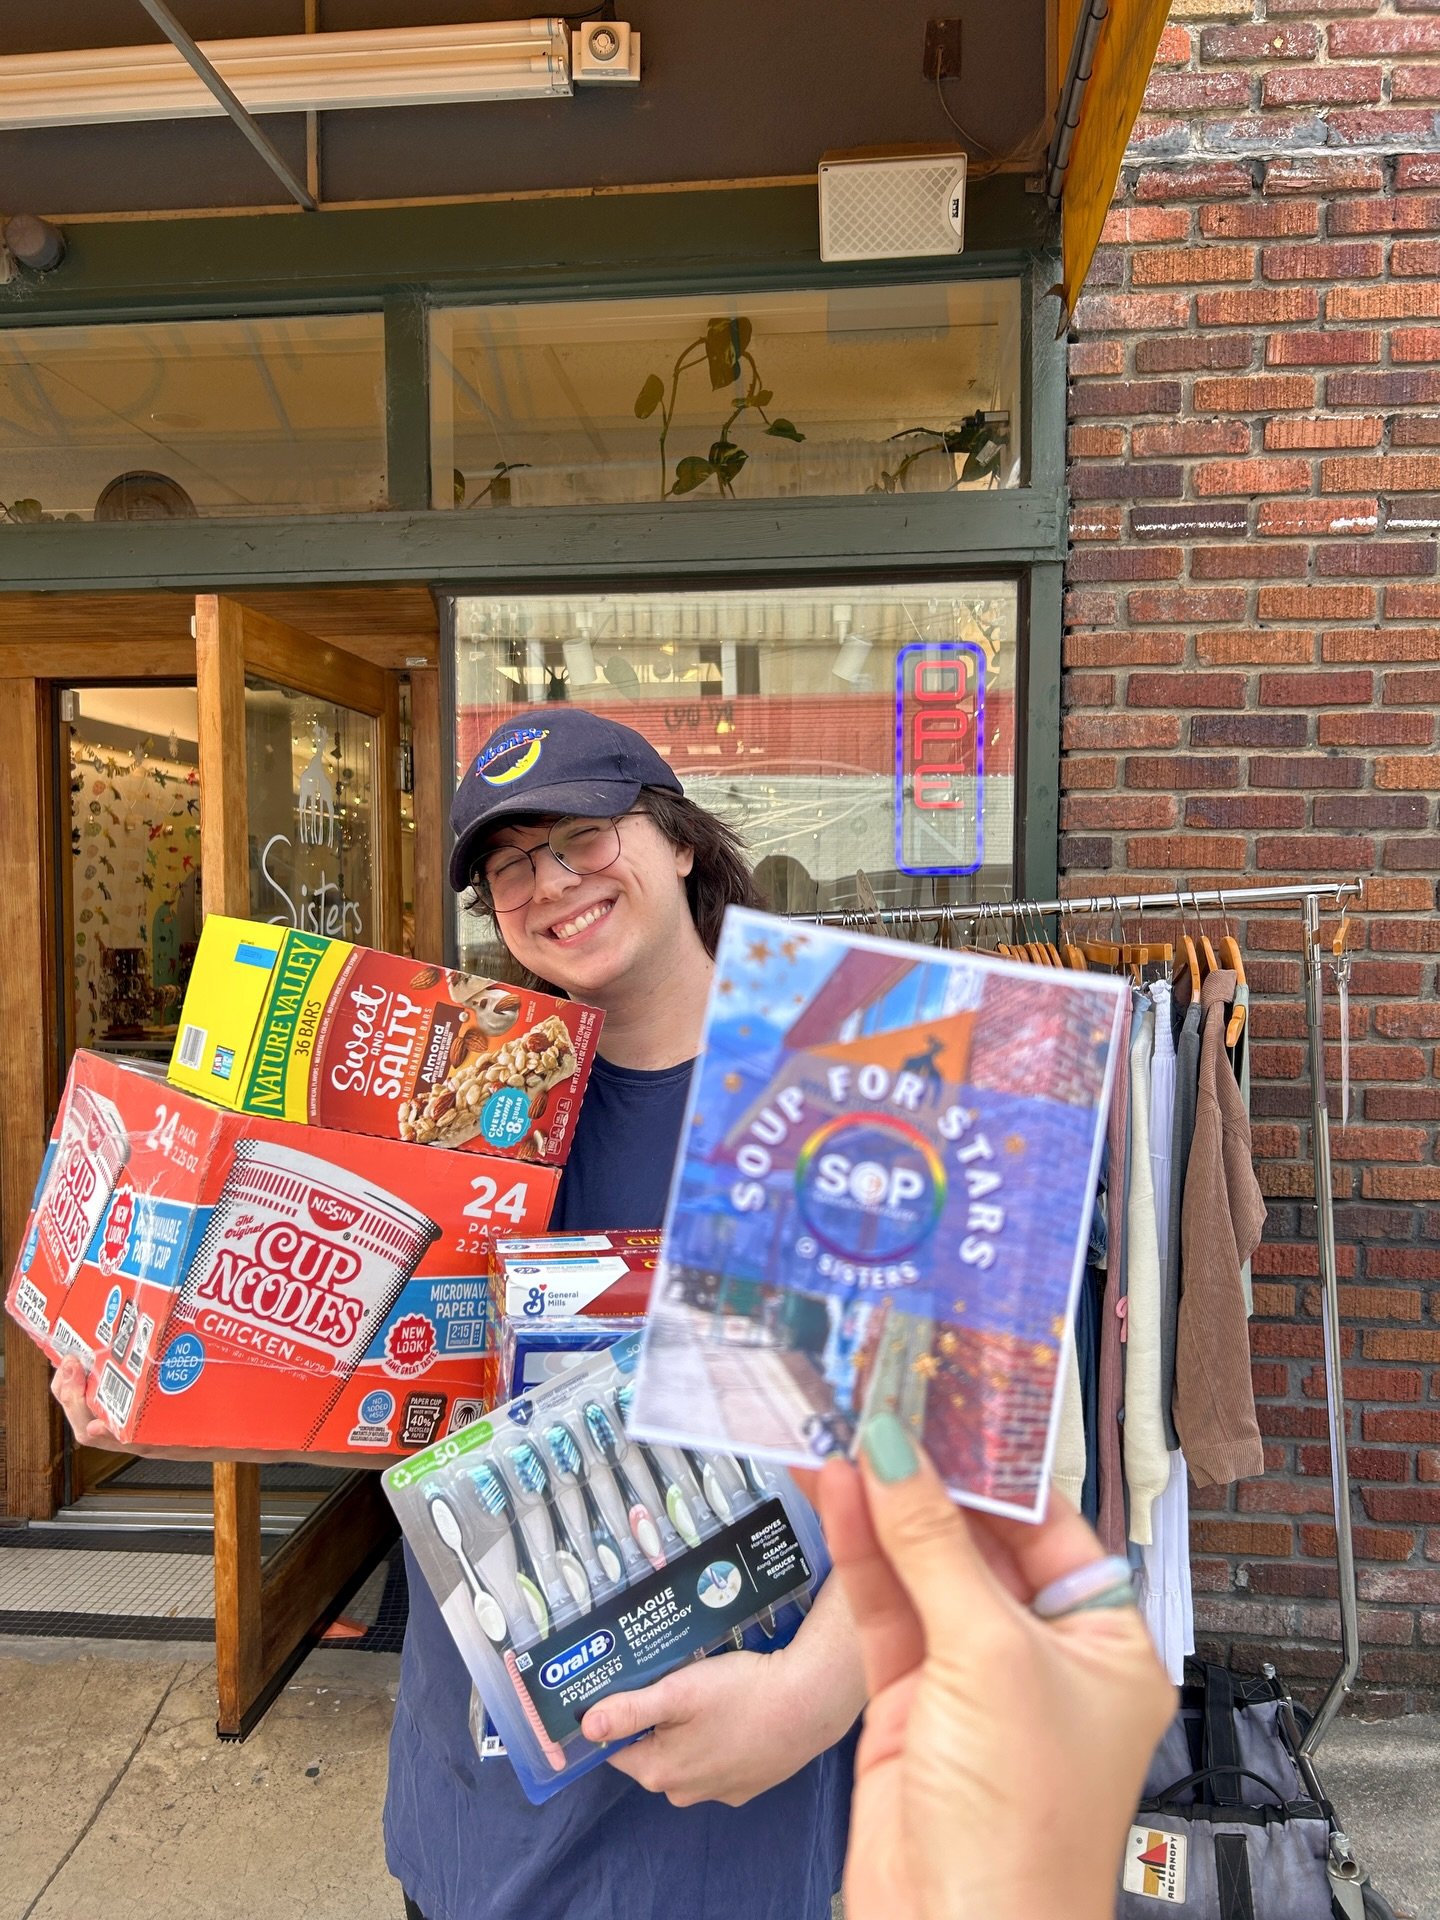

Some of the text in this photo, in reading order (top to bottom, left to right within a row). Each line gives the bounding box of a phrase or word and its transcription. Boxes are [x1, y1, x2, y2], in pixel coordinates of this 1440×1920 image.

[913, 659, 969, 863] OPEN
[262, 834, 362, 937] Sisters
[250, 938, 325, 1111] NATURE VALLEY
[294, 1000, 322, 1056] 36 BARS
[331, 984, 387, 1091] Sweet
[370, 1030, 385, 1056] AND
[373, 994, 422, 1099] SALTY
[401, 1007, 432, 1098] NUT GRANOLA BARS
[421, 1024, 445, 1083] Almond
[827, 1063, 927, 1111] FOR
[495, 1097, 514, 1137] Creamy
[511, 1096, 523, 1121] SUGAR
[146, 1104, 181, 1157] 24
[730, 1086, 804, 1212] SOUP
[66, 1142, 96, 1202] CUP
[186, 1154, 199, 1174] OZ
[462, 1176, 528, 1223] 24
[937, 1104, 1005, 1271] STARS
[49, 1177, 88, 1262] OODLES
[114, 1204, 130, 1223] NEW
[236, 1215, 254, 1227] The
[311, 1197, 355, 1224] NISSIN
[41, 1212, 62, 1261] CHICKEN
[107, 1225, 127, 1245] LOOK!
[224, 1223, 264, 1240] Original
[154, 1245, 171, 1270] CUP
[258, 1225, 359, 1291] CUP
[818, 1252, 920, 1291] SISTERS
[200, 1252, 361, 1345] NOODLES
[547, 1299, 566, 1307] Mills
[548, 1291, 579, 1300] General
[435, 1302, 475, 1319] PAPER
[203, 1314, 295, 1360] CHICKEN
[401, 1326, 426, 1340] NEW
[451, 1325, 469, 1339] 2:15
[175, 1343, 191, 1355] NO
[396, 1340, 428, 1354] LOOK!
[165, 1355, 199, 1369] ADDED
[166, 1369, 188, 1381] MSG
[385, 1359, 401, 1374] SAME
[400, 1366, 419, 1375] GREAT
[372, 1397, 383, 1405] NO
[410, 1397, 442, 1406] PAPER CUP
[411, 1415, 431, 1426] 40%
[432, 1439, 460, 1468] 50
[751, 1519, 782, 1541] REMOVES
[762, 1541, 787, 1560] CLEANS
[766, 1554, 796, 1576] REDUCES
[618, 1587, 675, 1629] PLAQUE
[624, 1601, 679, 1641] ERASER
[629, 1604, 693, 1650] TECHNOLOGY
[546, 1634, 608, 1684] Oral-B
[633, 1630, 673, 1659] for Superior
[636, 1649, 660, 1666] Plaque
[562, 1662, 623, 1706] ADVANCED
[1168, 1836, 1178, 1899] ABCCANOPY
